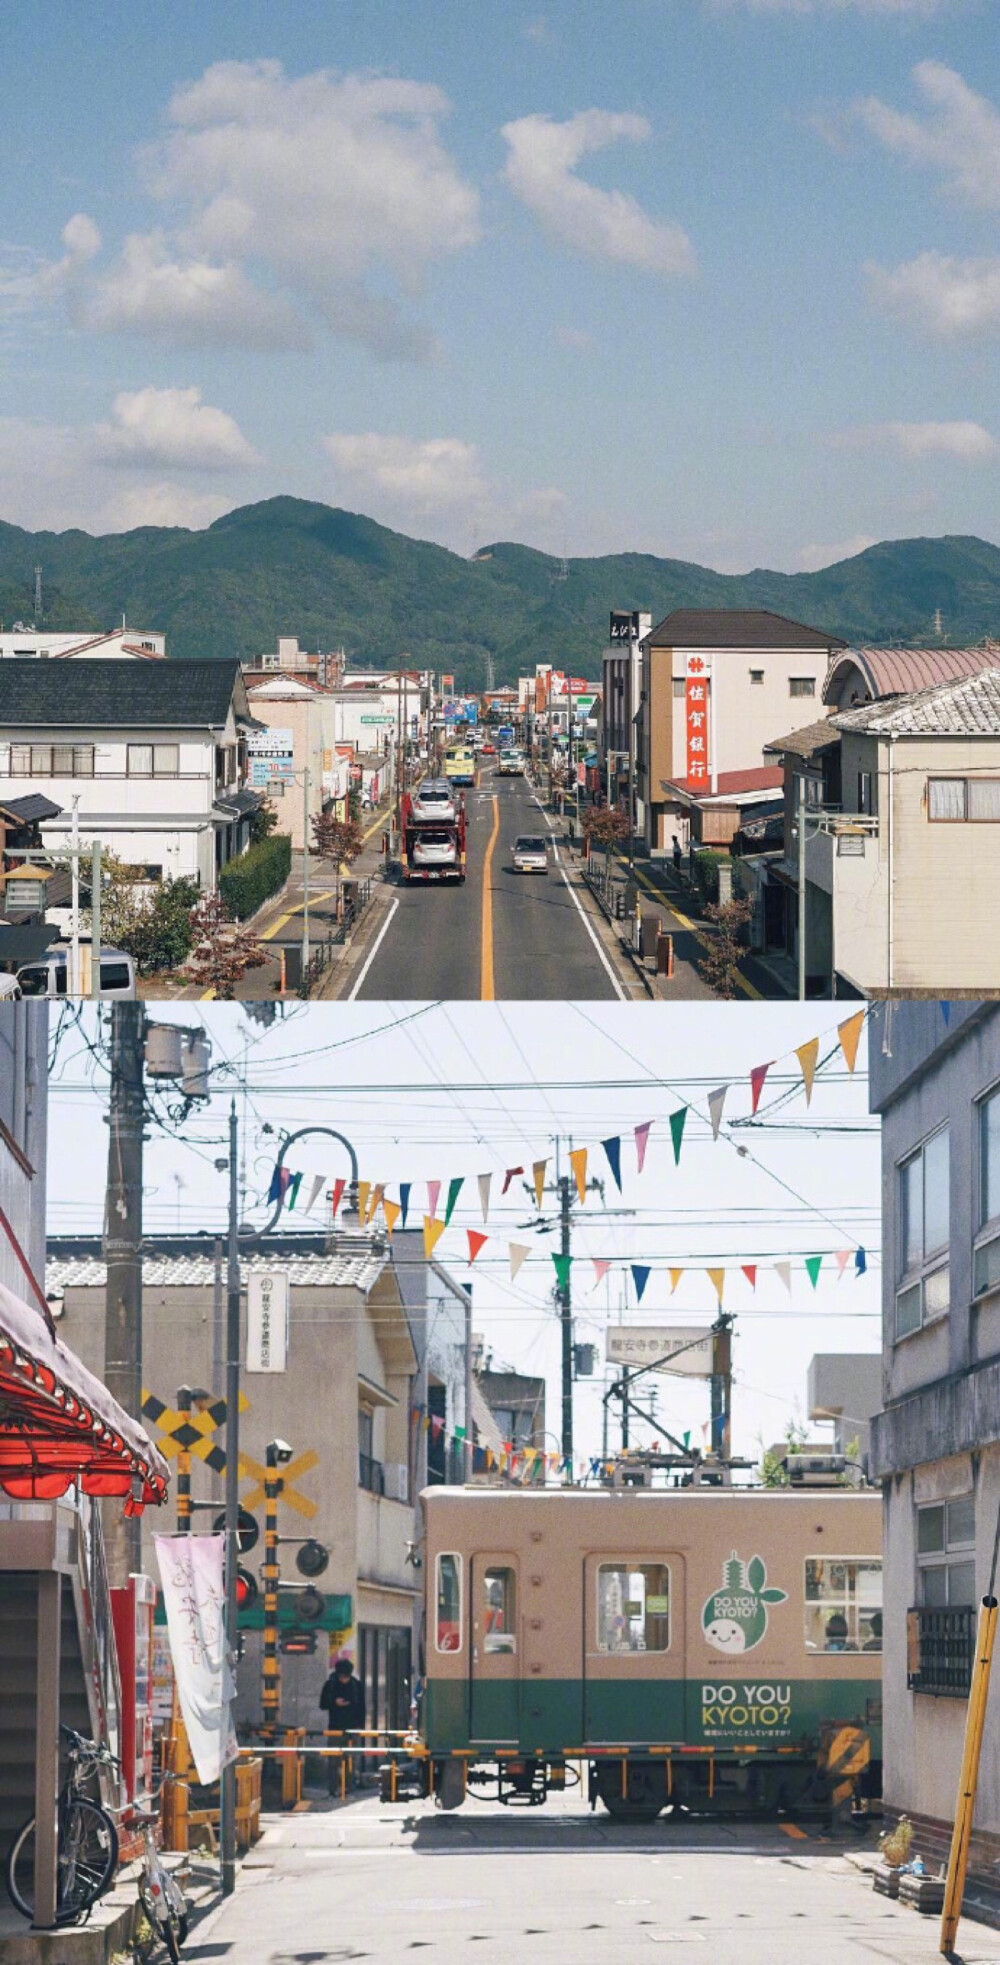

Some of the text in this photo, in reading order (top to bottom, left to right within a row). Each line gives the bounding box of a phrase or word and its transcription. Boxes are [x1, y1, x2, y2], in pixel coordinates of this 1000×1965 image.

[688, 685, 705, 778] 佐賀銀行
[714, 1597, 758, 1607] DO YOU
[714, 1607, 758, 1618] KYOTO?
[702, 1685, 791, 1704] DO YOU
[702, 1706, 791, 1725] KYOTO?
